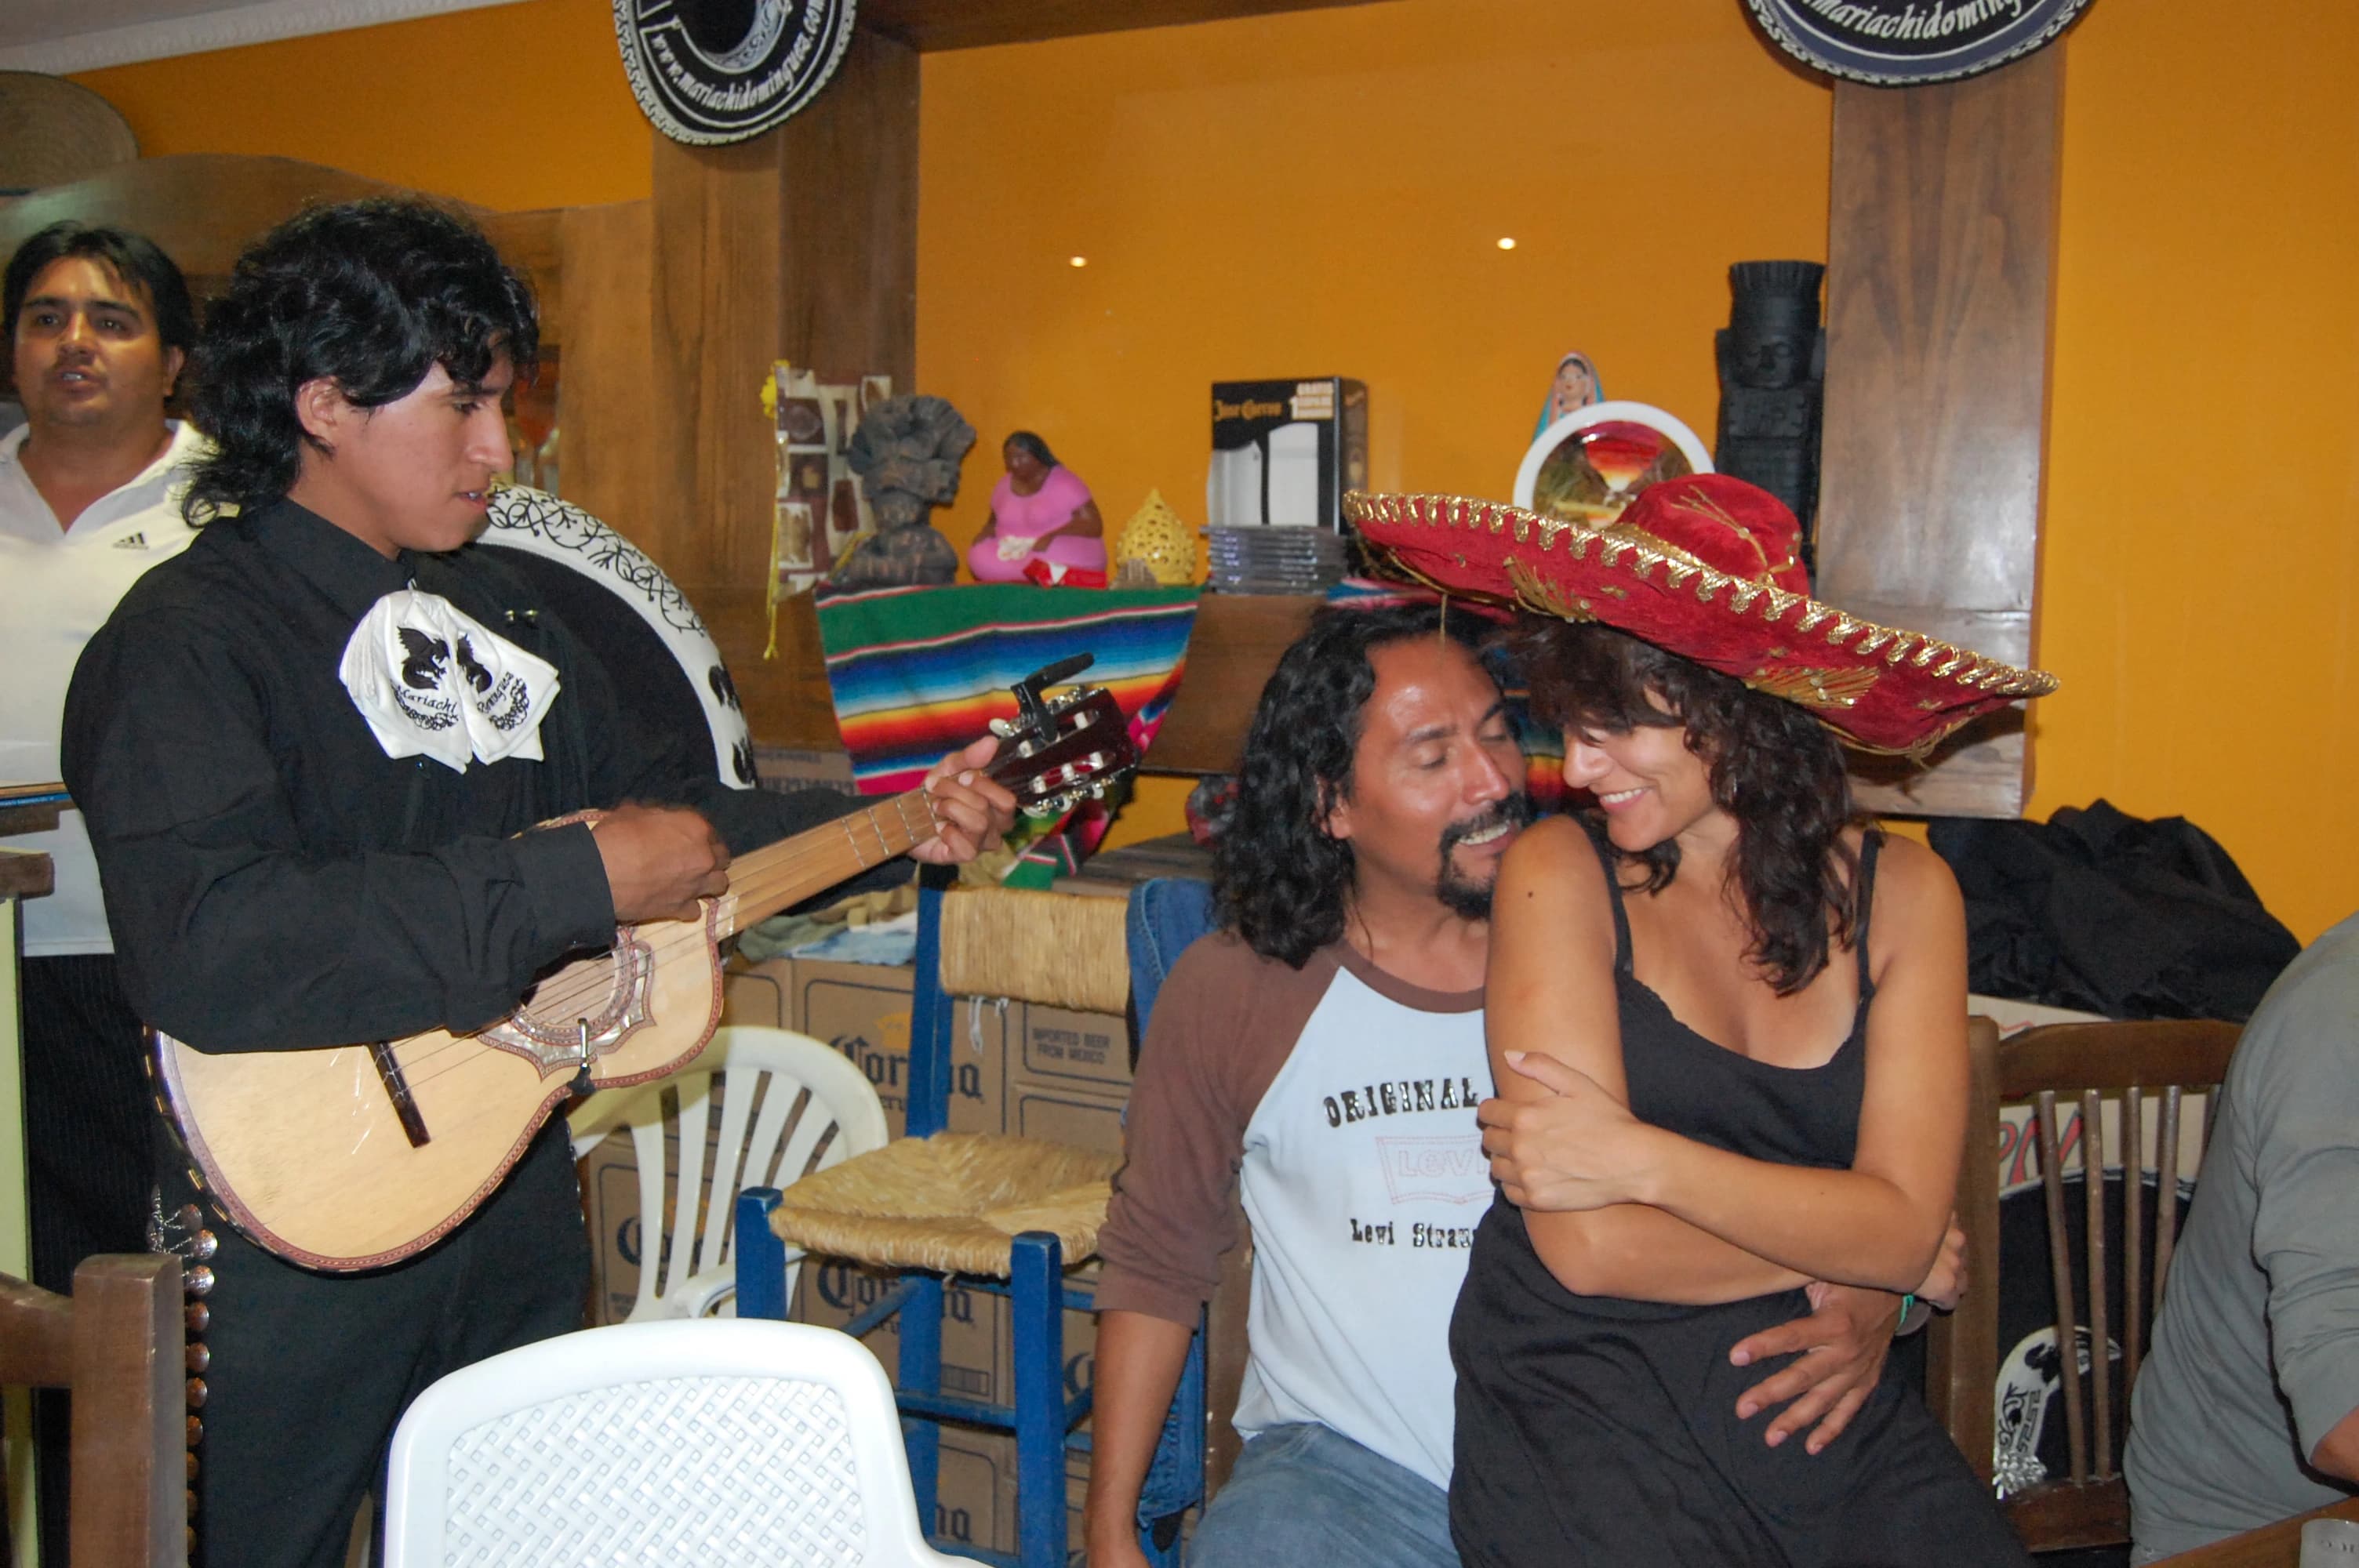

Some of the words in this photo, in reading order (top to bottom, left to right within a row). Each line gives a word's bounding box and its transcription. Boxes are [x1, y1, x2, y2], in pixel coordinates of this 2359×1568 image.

[1323, 1077, 1478, 1127] ORIGINAL
[1350, 1218, 1394, 1245] Levi
[1412, 1223, 1478, 1248] Strau
